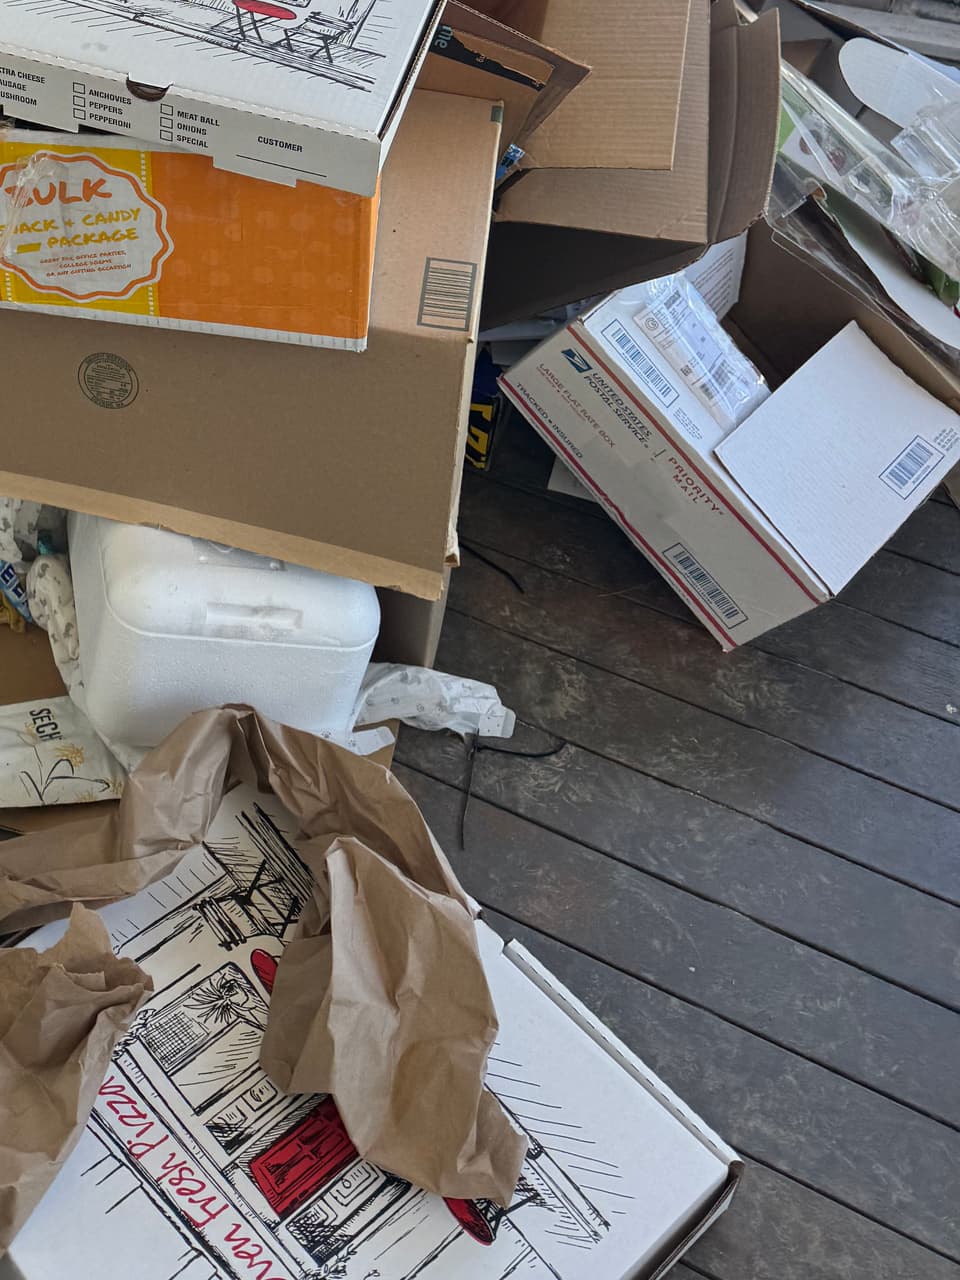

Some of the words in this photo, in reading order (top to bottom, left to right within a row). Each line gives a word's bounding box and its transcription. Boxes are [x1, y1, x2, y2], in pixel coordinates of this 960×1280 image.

[17, 71, 45, 84] CHEESE
[89, 89, 132, 105] ANCHOVIES
[89, 101, 123, 116] PEPPERS
[177, 110, 198, 121] MEAT
[200, 116, 220, 127] BALL
[89, 113, 131, 129] PEPPERONI
[177, 122, 207, 136] ONIONS
[176, 134, 209, 148] SPECIAL
[257, 136, 303, 153] CUSTOMER
[81, 208, 141, 227] CANDY
[47, 227, 139, 249] PACKAGE
[583, 375, 614, 413] POSTAL
[539, 362, 564, 391] LARGE
[562, 389, 582, 408] FLAT
[580, 404, 599, 428] RATE
[597, 427, 616, 448] BOX
[591, 372, 625, 408] UNITED
[622, 404, 653, 439] STATES
[516, 382, 549, 420] TRACKED
[552, 423, 584, 459] INSURED
[672, 473, 699, 504] MAIL
[97, 1075, 170, 1162] Pizza
[155, 1152, 230, 1229] Fresh
[224, 1222, 292, 1280] ven
